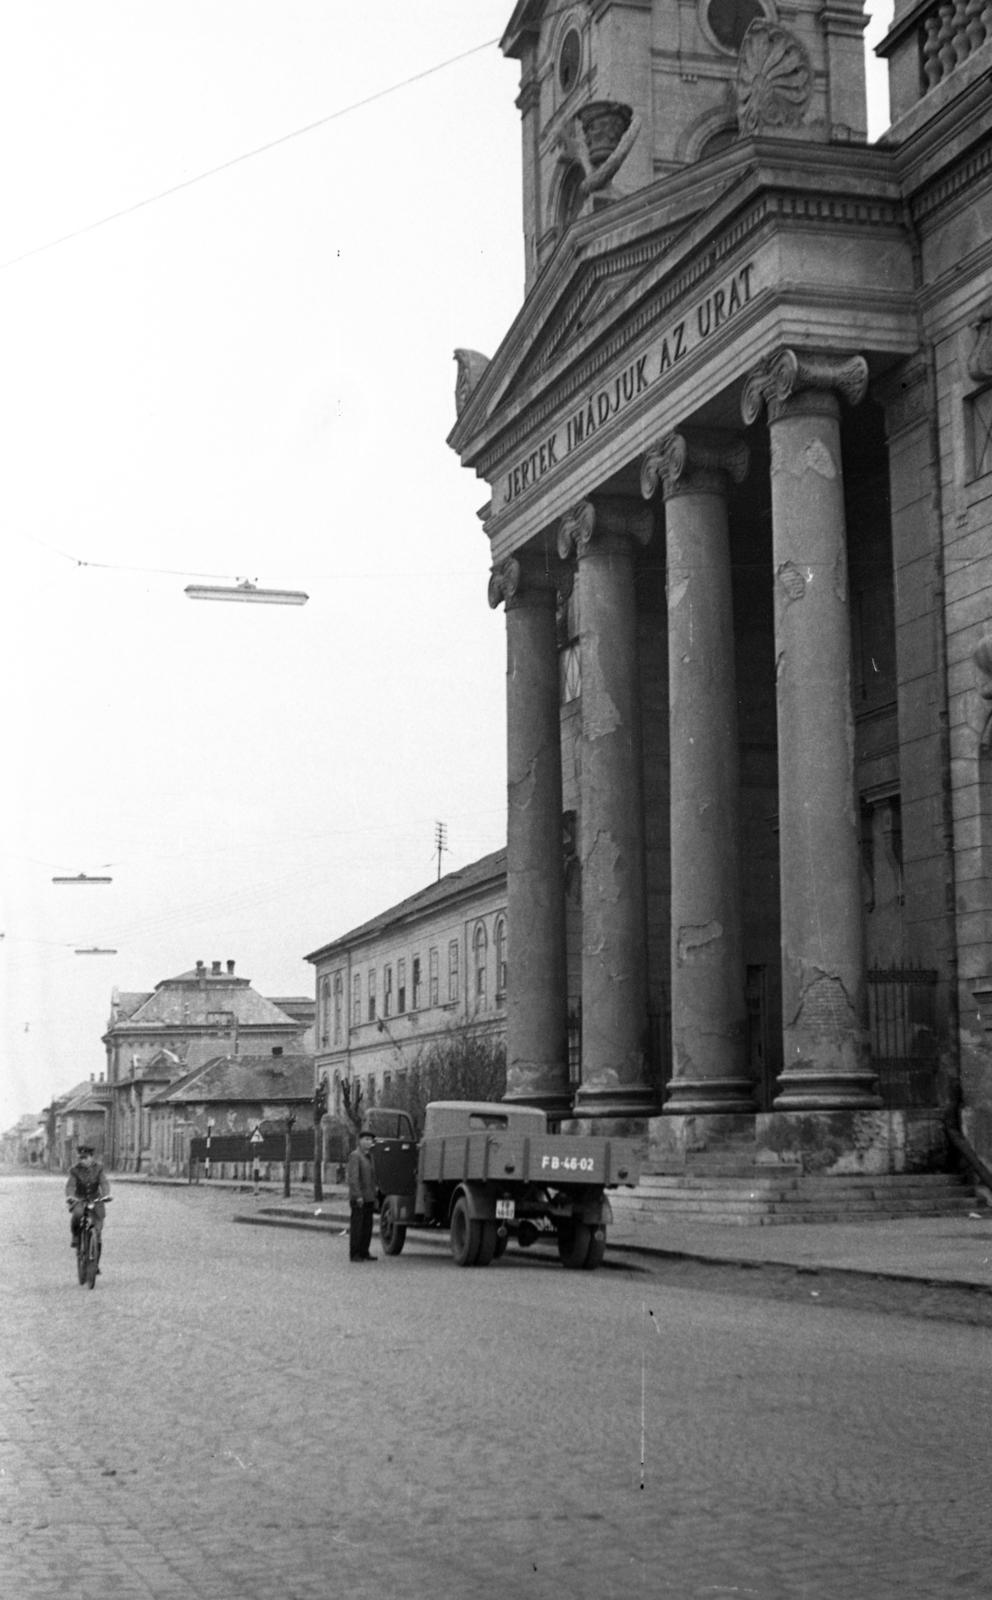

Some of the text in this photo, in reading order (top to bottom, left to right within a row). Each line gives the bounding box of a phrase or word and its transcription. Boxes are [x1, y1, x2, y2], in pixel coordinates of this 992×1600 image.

[504, 262, 755, 503] JERTEK IMÁDJUK AZ URAT
